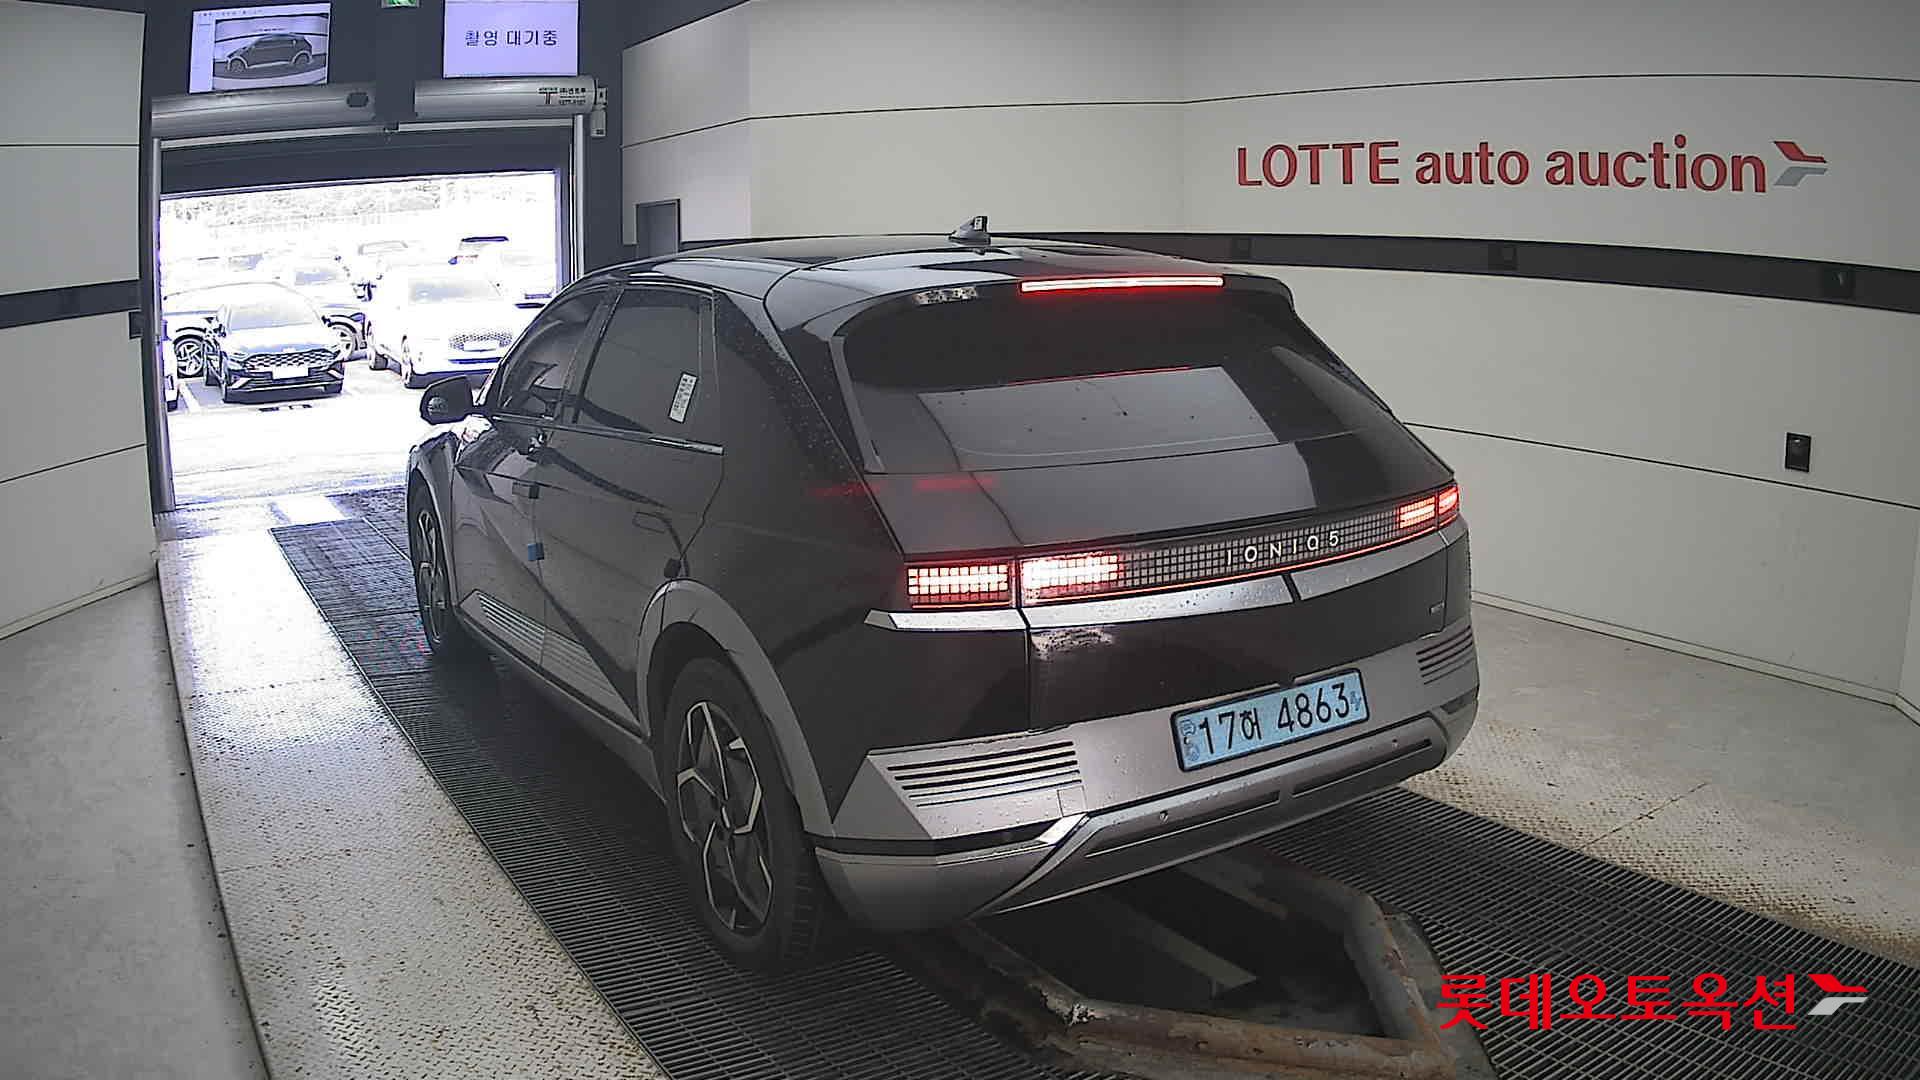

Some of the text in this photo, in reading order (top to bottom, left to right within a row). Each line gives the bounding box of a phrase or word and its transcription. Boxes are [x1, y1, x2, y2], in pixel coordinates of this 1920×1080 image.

[465, 30, 557, 46] 촬영 대기중
[1237, 134, 1766, 194] LOTTE auto auction
[1227, 531, 1340, 565] IONIQ 5
[1277, 683, 1350, 732] 4863
